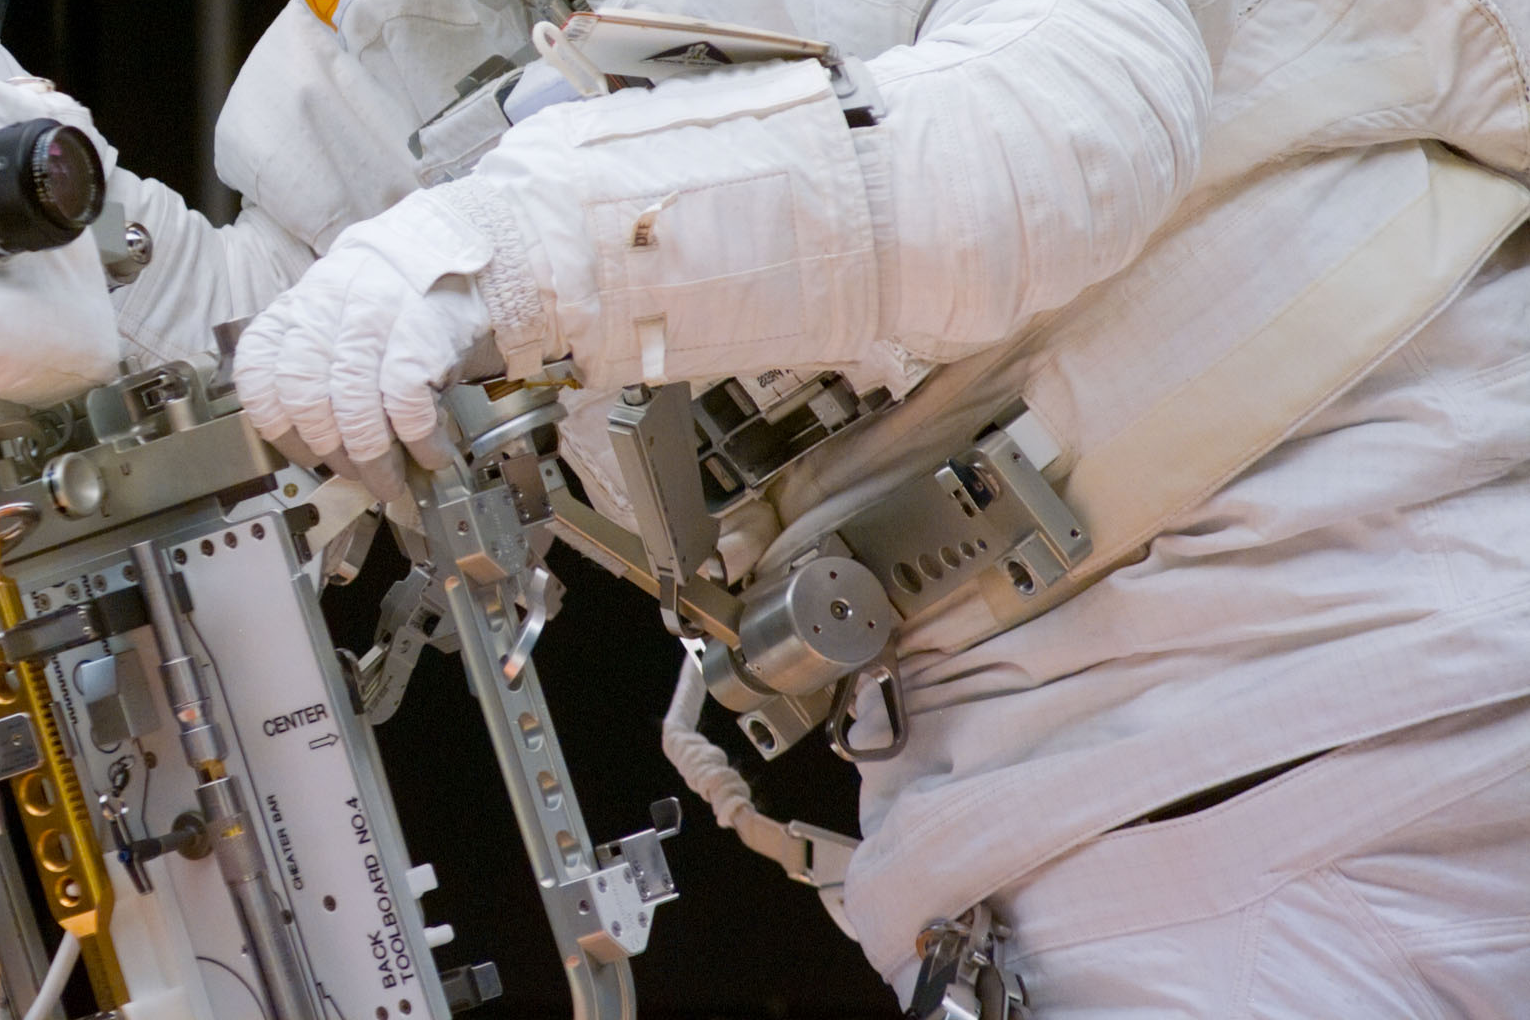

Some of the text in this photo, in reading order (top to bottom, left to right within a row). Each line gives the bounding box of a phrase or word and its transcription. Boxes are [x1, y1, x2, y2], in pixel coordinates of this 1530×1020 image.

[263, 703, 328, 737] CENTER
[267, 794, 304, 891] CHEATER BAR
[346, 795, 415, 987] TOOLBOARD NO.4
[367, 930, 398, 990] BACK
